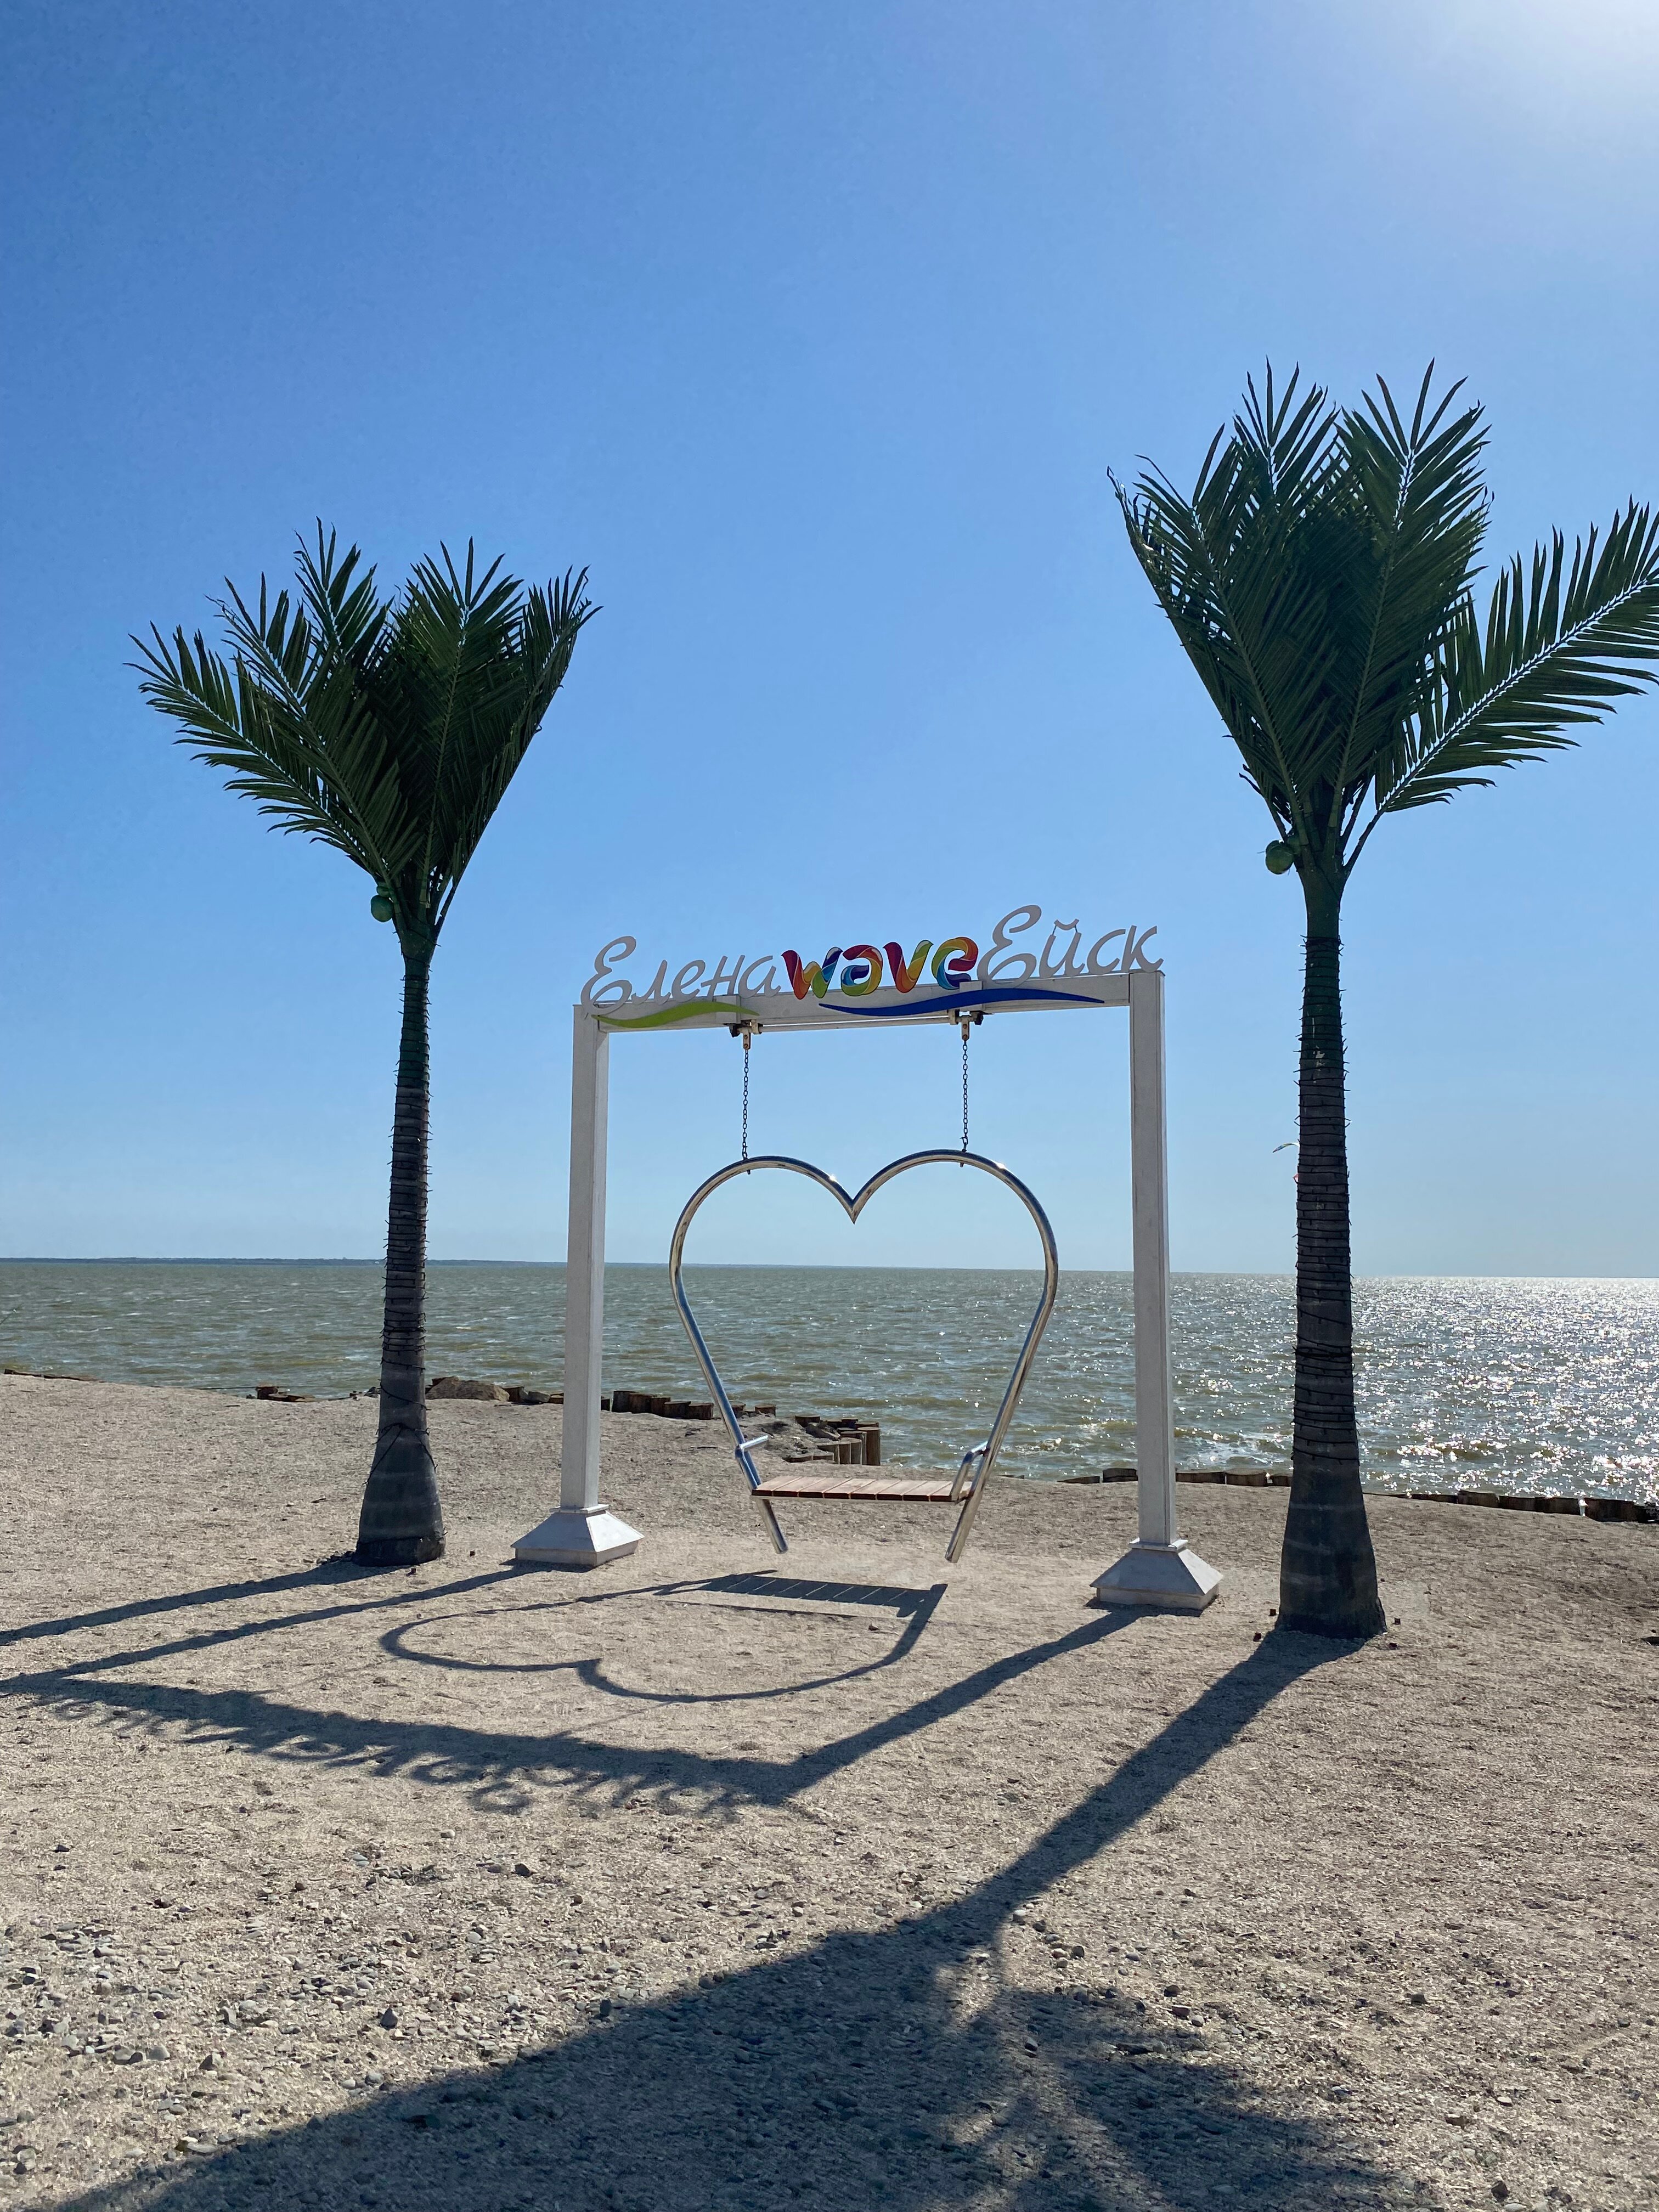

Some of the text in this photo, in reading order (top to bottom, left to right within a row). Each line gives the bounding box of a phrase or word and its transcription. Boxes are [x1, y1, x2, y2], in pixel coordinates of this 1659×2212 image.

[580, 905, 1164, 1016] Елена wave Ейск
